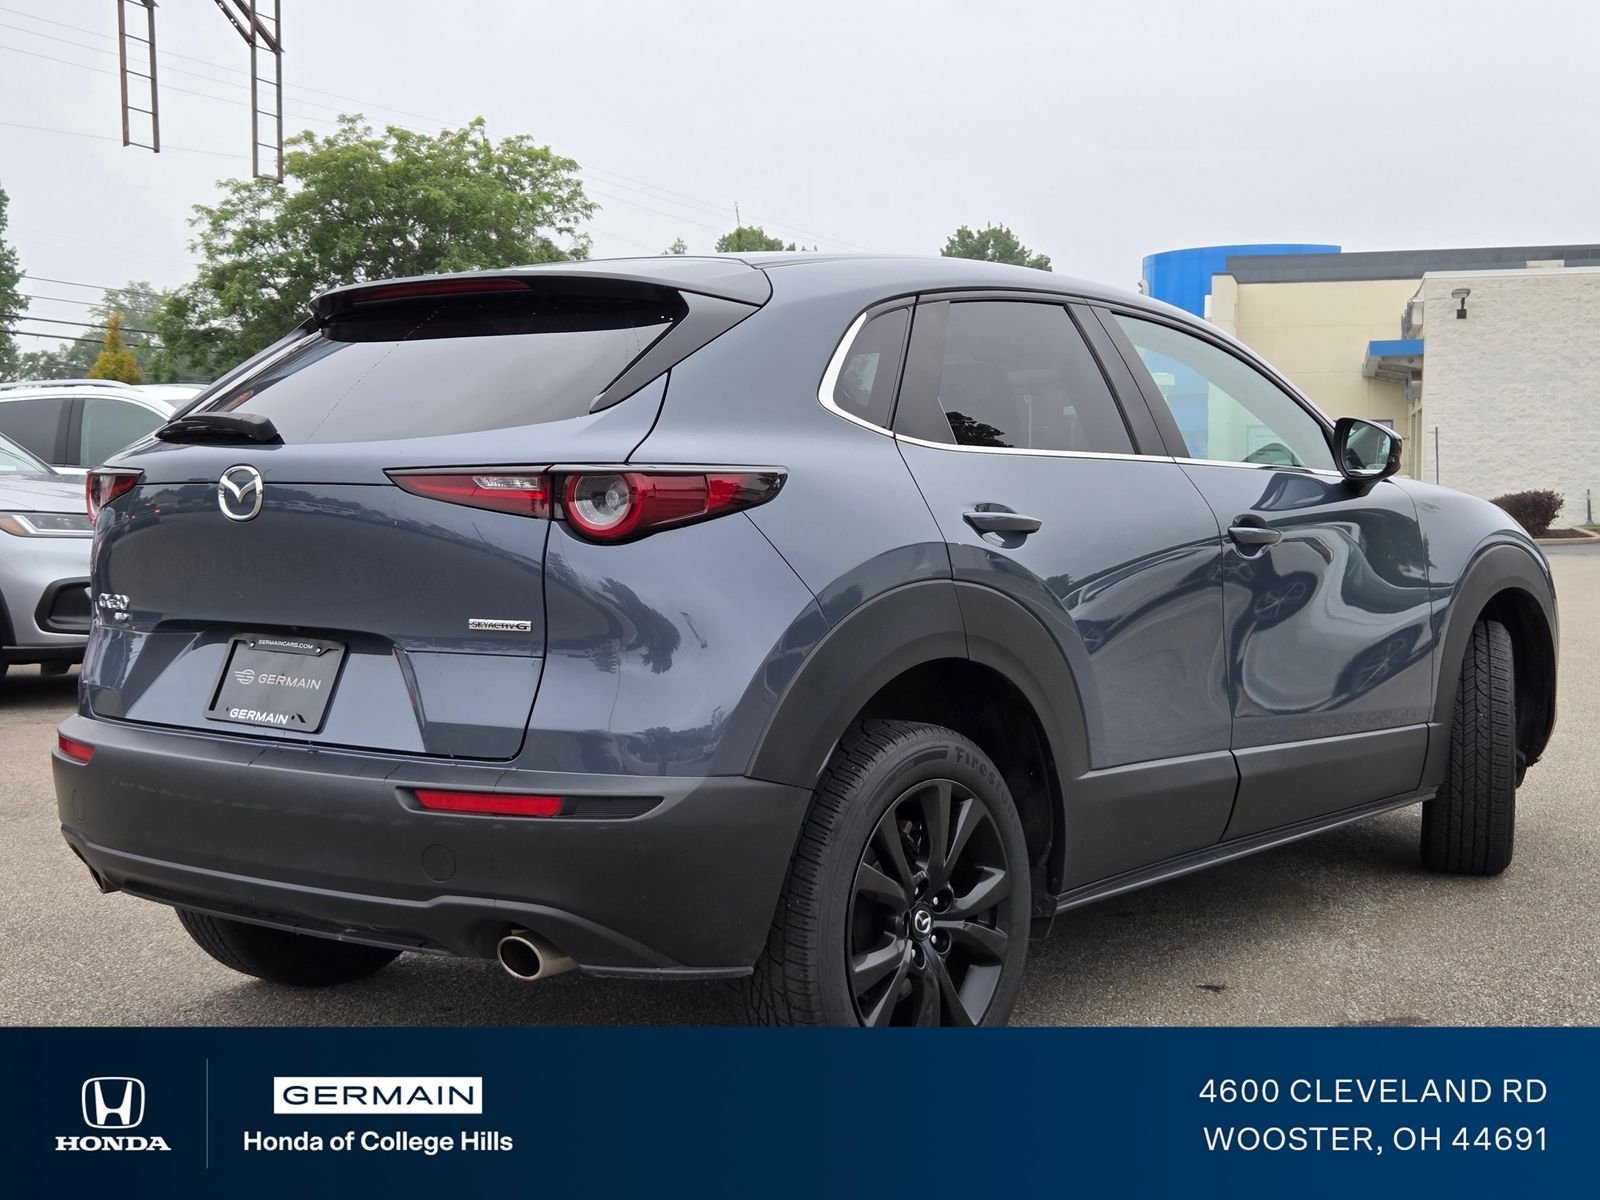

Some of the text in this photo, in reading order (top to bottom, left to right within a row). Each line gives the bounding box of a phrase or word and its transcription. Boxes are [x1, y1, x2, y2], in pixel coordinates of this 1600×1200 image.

[257, 638, 315, 650] GERMAINCARS.COM
[257, 673, 322, 690] GERMAIN
[229, 707, 289, 725] GERMAIN
